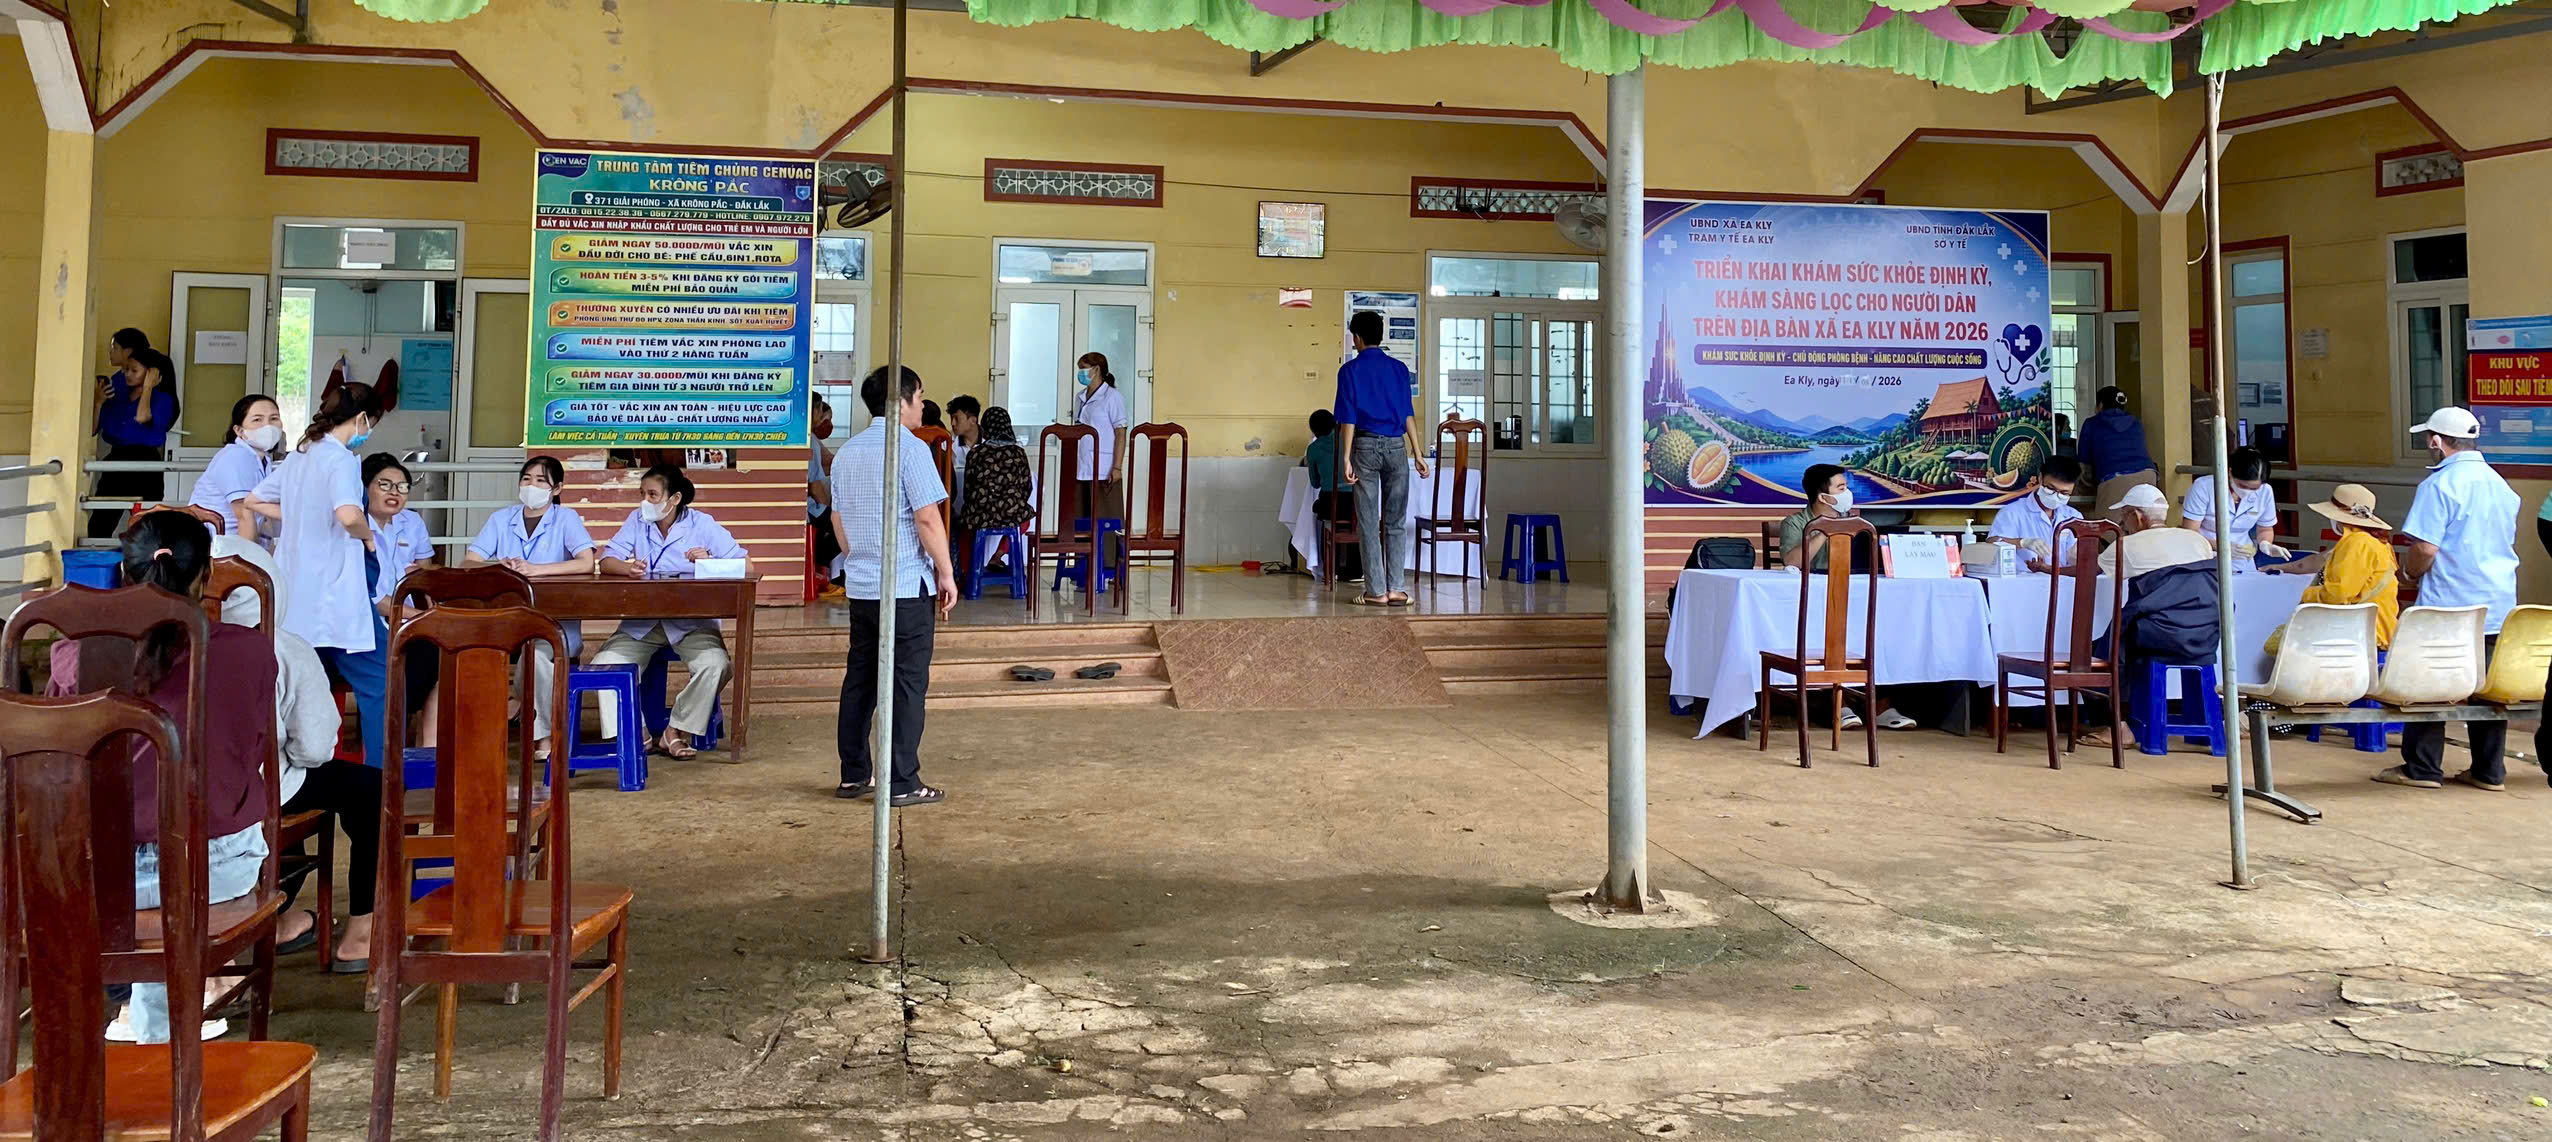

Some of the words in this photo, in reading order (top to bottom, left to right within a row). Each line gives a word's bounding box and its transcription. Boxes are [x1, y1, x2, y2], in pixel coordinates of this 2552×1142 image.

[597, 160, 639, 172] TRUNG
[644, 160, 672, 174] TÂM
[678, 162, 709, 175] TIÊM
[715, 162, 757, 176] CHỦNG
[650, 178, 708, 192] KRÔNG
[614, 196, 629, 205] GIẢI
[632, 197, 660, 206] PHÓNG
[668, 199, 679, 207] XÃ
[682, 199, 709, 208] KRÔNG
[712, 198, 727, 208] PẮC
[1691, 219, 1718, 228] UBND
[1723, 217, 1737, 228] XÃ
[1741, 220, 1752, 229] EA
[1755, 220, 1772, 229] KLY
[1907, 226, 1931, 234] UBND
[1720, 234, 1726, 243] Y
[1729, 232, 1740, 243] TẾ
[1743, 235, 1754, 243] EA
[1758, 235, 1774, 244] KLY
[1958, 238, 1967, 249] TẾ
[580, 271, 609, 279] HOÀN
[614, 271, 636, 279] TIỀN
[693, 274, 722, 282] ĐĂNG
[726, 274, 739, 282] KÝ
[763, 275, 788, 284] TIÊM
[1695, 255, 1742, 280] TRIỂN
[1748, 262, 1786, 280] KHAI
[1792, 260, 1841, 282] KHÁM
[1847, 261, 1879, 282] SỨC
[1884, 260, 1925, 284] KHỎE
[1930, 266, 1966, 289] ĐỊNH
[1971, 264, 1992, 287] KỲ,
[1715, 288, 1766, 309] KHÁM
[1772, 288, 1816, 310] SÀNG
[1822, 292, 1852, 314] LỌC
[1857, 293, 1888, 312] CHO
[1892, 291, 1940, 312] NGƯỜI
[1945, 292, 1976, 313] DÂN
[1694, 315, 1736, 337] TRÊN
[1742, 319, 1770, 341] ĐỊA
[1776, 316, 1810, 338] BÀN
[1815, 317, 1838, 339] XÃ
[1843, 320, 1862, 339] EA
[1868, 321, 1896, 339] KLY
[1900, 318, 1940, 340] NĂM
[1945, 322, 1988, 341] 2026
[582, 337, 612, 345] MIỄN
[616, 337, 635, 346] PHÍ
[672, 337, 694, 346] VẮC
[722, 339, 761, 347] PHÒNG
[1703, 349, 1723, 361] KHÁM
[1725, 350, 1738, 361] SỨC
[1740, 349, 1757, 361] KHỎE
[1759, 352, 1775, 364] ĐỊNH
[1777, 351, 1786, 362] KỲ
[1793, 350, 1806, 362] CHỦ
[1808, 351, 1825, 364] ĐỘNG
[1828, 351, 1849, 363] PHÒNG
[1852, 352, 1868, 365] BỆNH
[1874, 351, 1891, 364] NÂNG
[1893, 354, 1905, 364] CAO
[1907, 352, 1924, 364] CHẤT
[1925, 353, 1946, 366] LƯỢNG
[1948, 353, 1963, 366] CUỘC
[1965, 352, 1981, 364] SỐNG
[2490, 358, 2512, 368] KHU
[2517, 355, 2540, 370] VỰC
[1784, 376, 1795, 384] Ea
[1798, 376, 1815, 387] Kly,
[1818, 377, 1839, 387] ngày
[1878, 377, 1902, 385] 2026
[2476, 379, 2497, 395] THEO
[2500, 375, 2514, 395] DÕI
[2516, 379, 2531, 395] SAU
